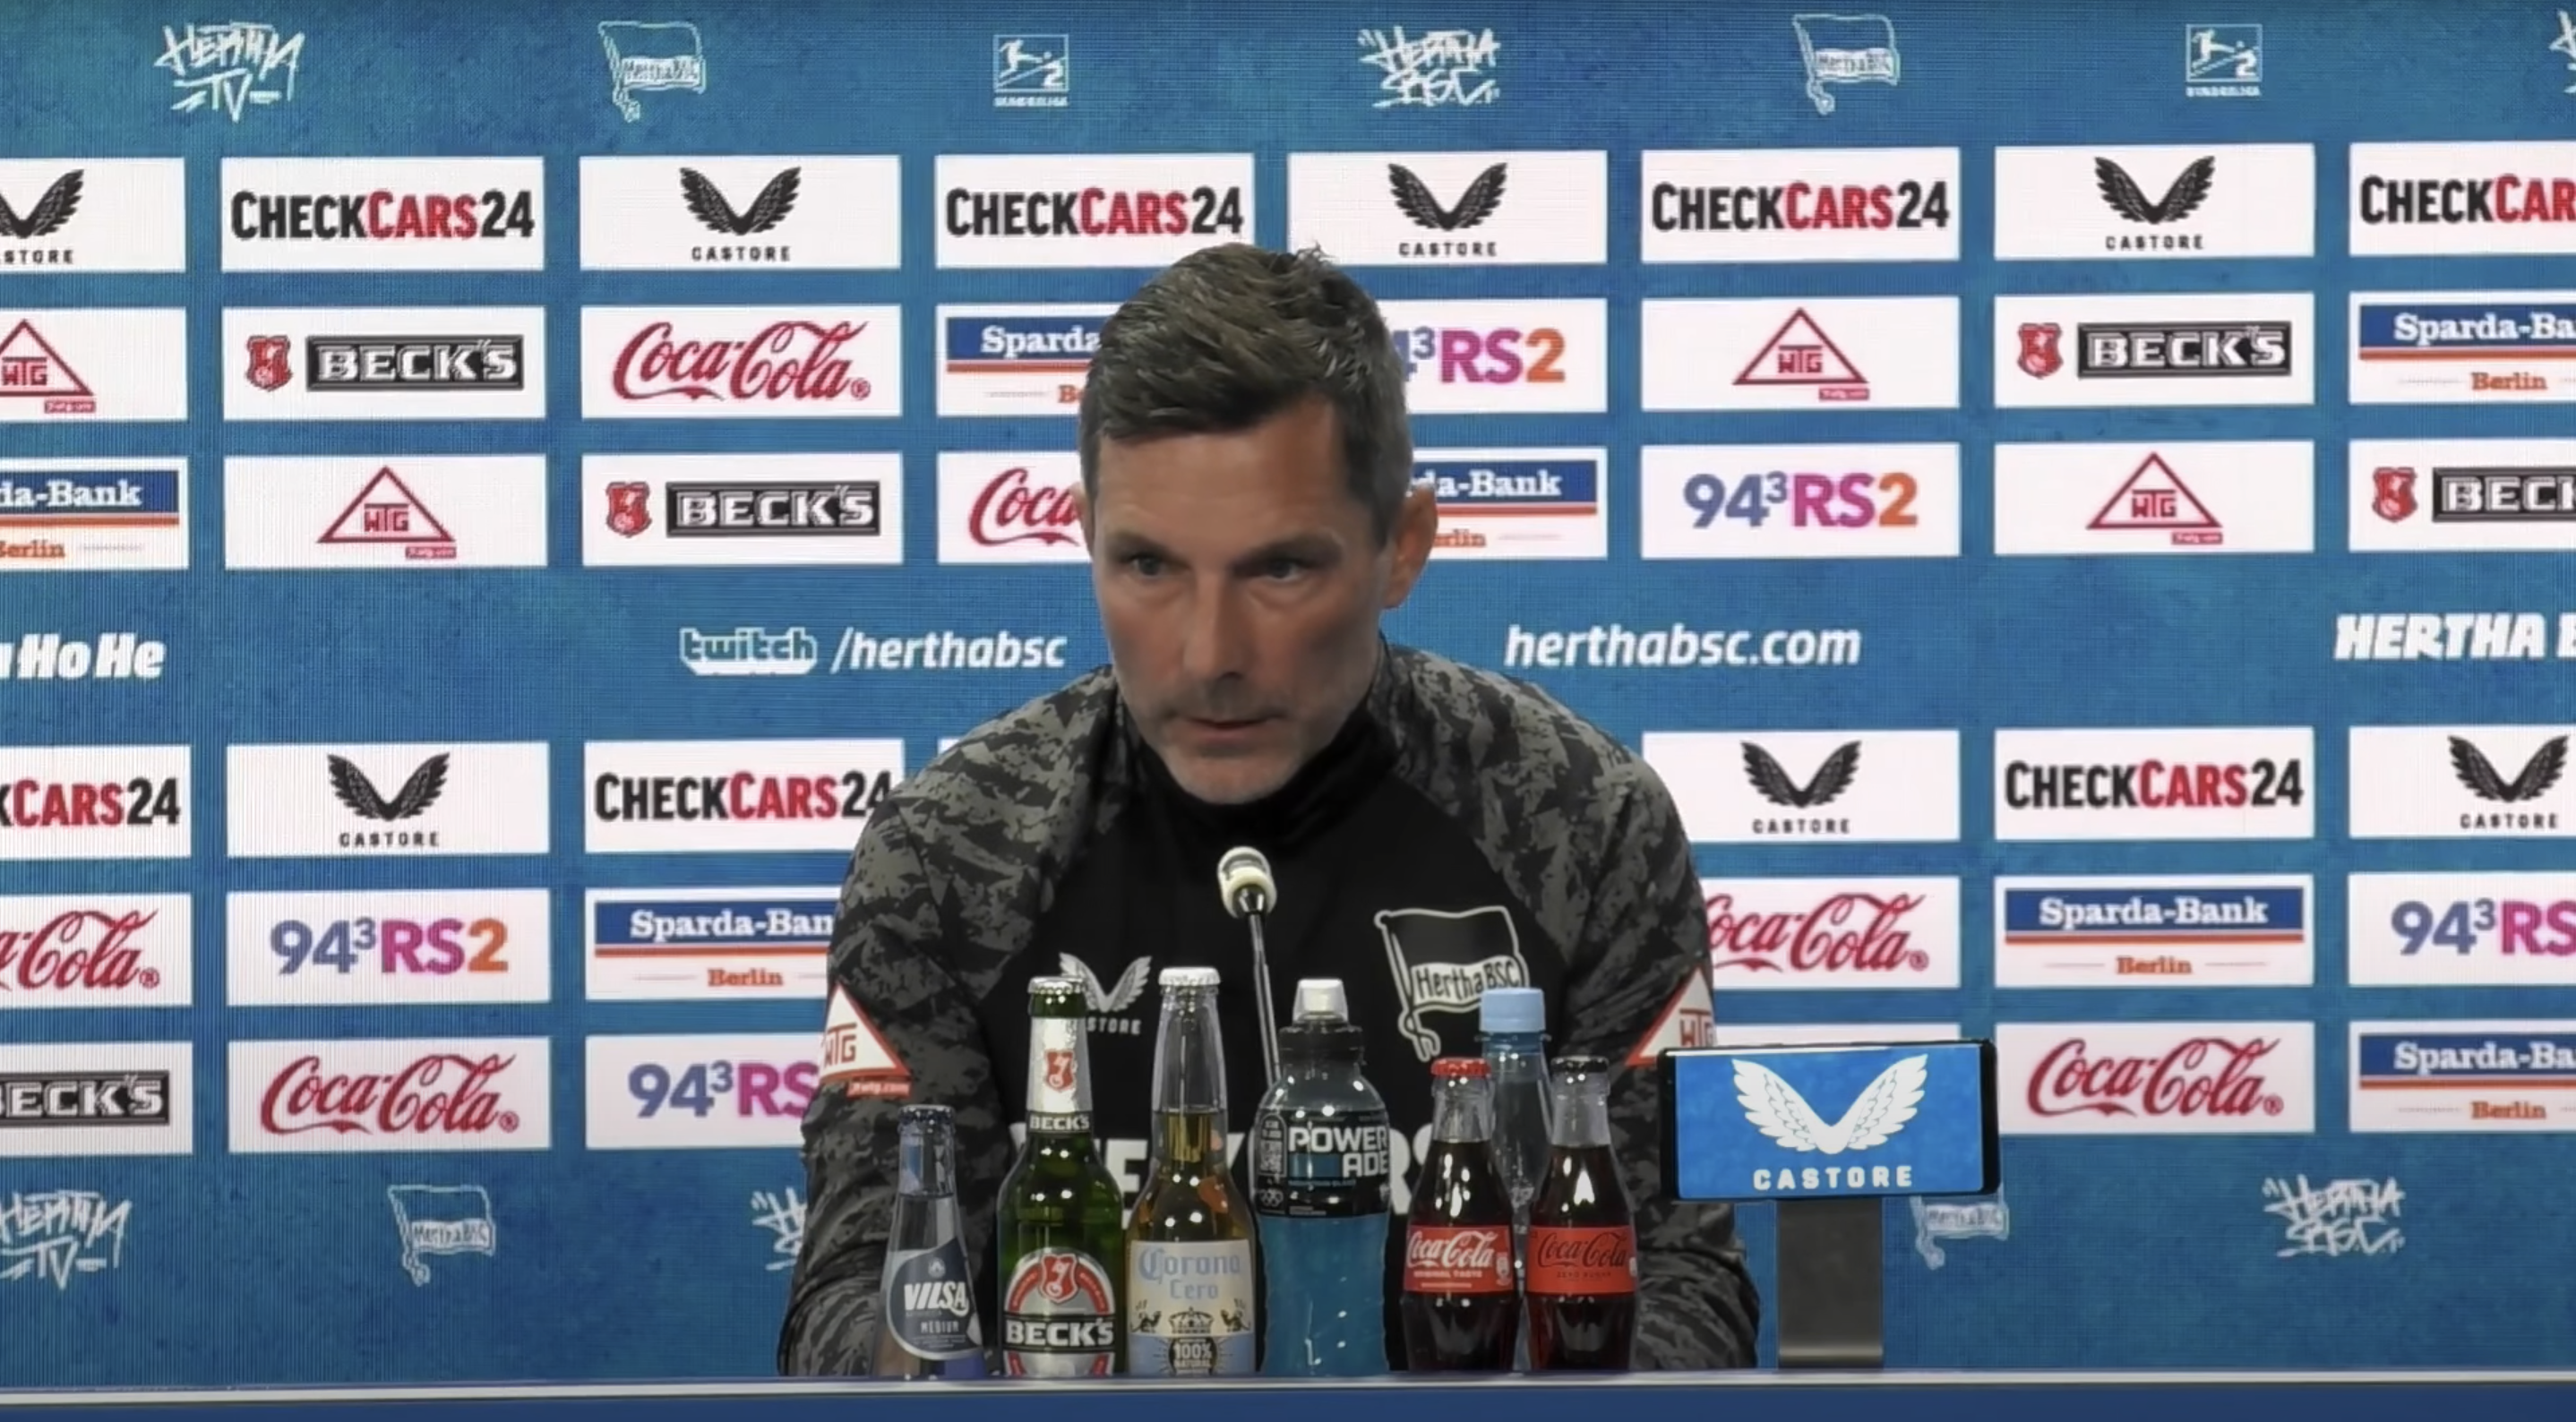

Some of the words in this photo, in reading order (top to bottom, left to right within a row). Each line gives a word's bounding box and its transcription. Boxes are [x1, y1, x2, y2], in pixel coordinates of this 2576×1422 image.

[2360, 174, 2576, 224] CHECKCAR
[4, 250, 72, 264] STORE
[692, 246, 788, 261] CASTORE
[1399, 242, 1495, 256] CASTORE
[2107, 236, 2202, 249] CASTORE
[983, 327, 1101, 359] Sparda
[2395, 313, 2576, 346] Sparda-Ba
[317, 337, 519, 381] BECK'S
[1777, 344, 1824, 373] WTG
[2088, 328, 2286, 368] BECK'S
[2, 356, 47, 386] WTG
[2471, 373, 2546, 390] Berlin
[364, 502, 409, 532] WTG
[677, 486, 874, 527] BECK'S
[2132, 489, 2177, 518] WTG
[682, 630, 816, 663] twitch
[1505, 625, 1861, 666] herthabsc.com
[2334, 613, 2546, 659] HERTHA
[1753, 819, 1848, 833] CASTORE
[2460, 814, 2555, 828] CASTORE
[339, 832, 436, 847] CASTORE
[631, 911, 833, 943] Sparda-Ban
[2040, 899, 2267, 935] Sparda-Bank
[708, 969, 783, 987] Berlin
[2117, 956, 2192, 974] Berlin
[1086, 1017, 1141, 1034] STORE
[2396, 1043, 2576, 1075] Sparda-Ba
[0, 1075, 163, 1117] ECK'S
[2470, 1101, 2546, 1119] Berlin
[1030, 1114, 1090, 1131] BECK'S
[1289, 1125, 1387, 1152] POWER
[1343, 1151, 1388, 1178] ADE
[1755, 1166, 1911, 1189] CASTORE
[1407, 1230, 1498, 1268] Coca-Cola
[1538, 1231, 1628, 1268] Coca-Cola
[1138, 1248, 1241, 1284] Corona
[904, 1281, 970, 1317] VILSA
[1170, 1279, 1219, 1299] Cero
[1005, 1318, 1114, 1347] BECK'S
[1174, 1344, 1213, 1359] 100%
